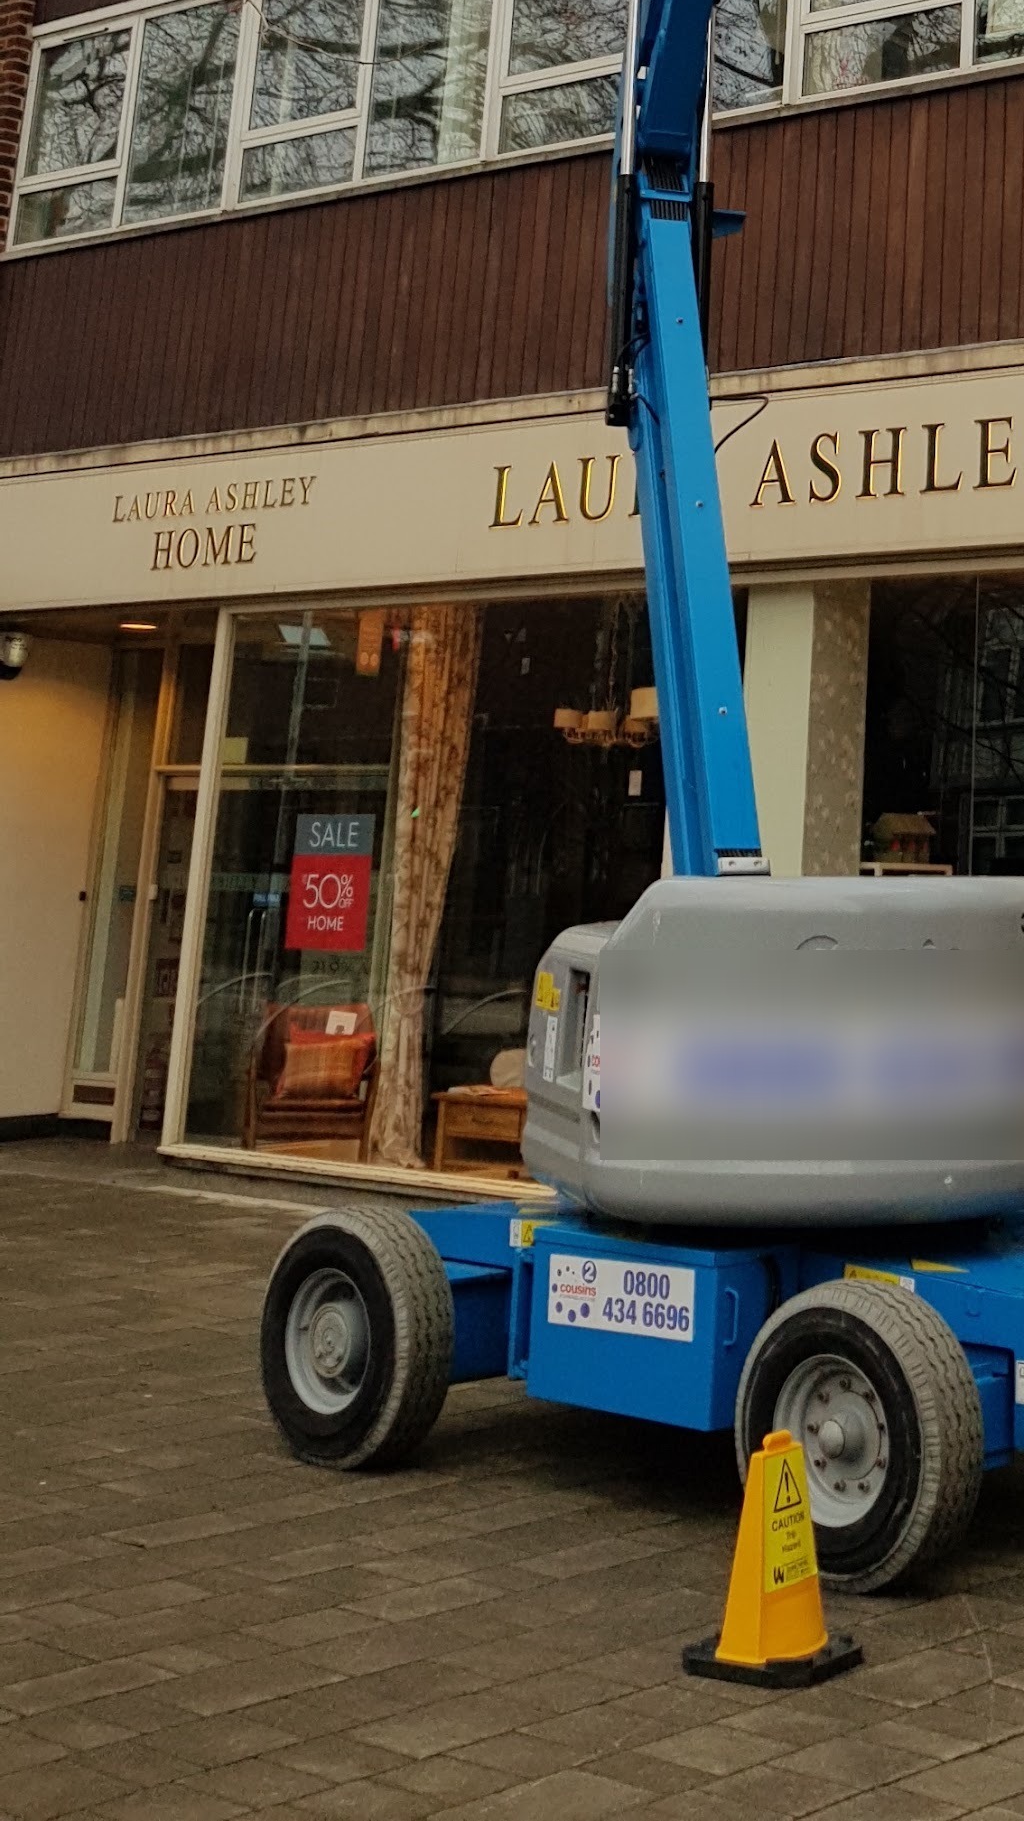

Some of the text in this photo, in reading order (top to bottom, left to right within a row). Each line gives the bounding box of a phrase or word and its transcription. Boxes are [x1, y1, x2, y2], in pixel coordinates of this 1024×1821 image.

[112, 476, 318, 523] LAURA ASHLEY
[489, 455, 641, 529] LAU
[150, 523, 257, 571] HOME
[309, 822, 359, 847] SALE
[303, 874, 354, 909] 50%
[307, 916, 344, 931] HOME
[560, 1283, 596, 1297] cousins
[623, 1270, 670, 1300] 0800
[602, 1297, 690, 1331] 434 6696
[772, 1511, 805, 1532] CAUTION
